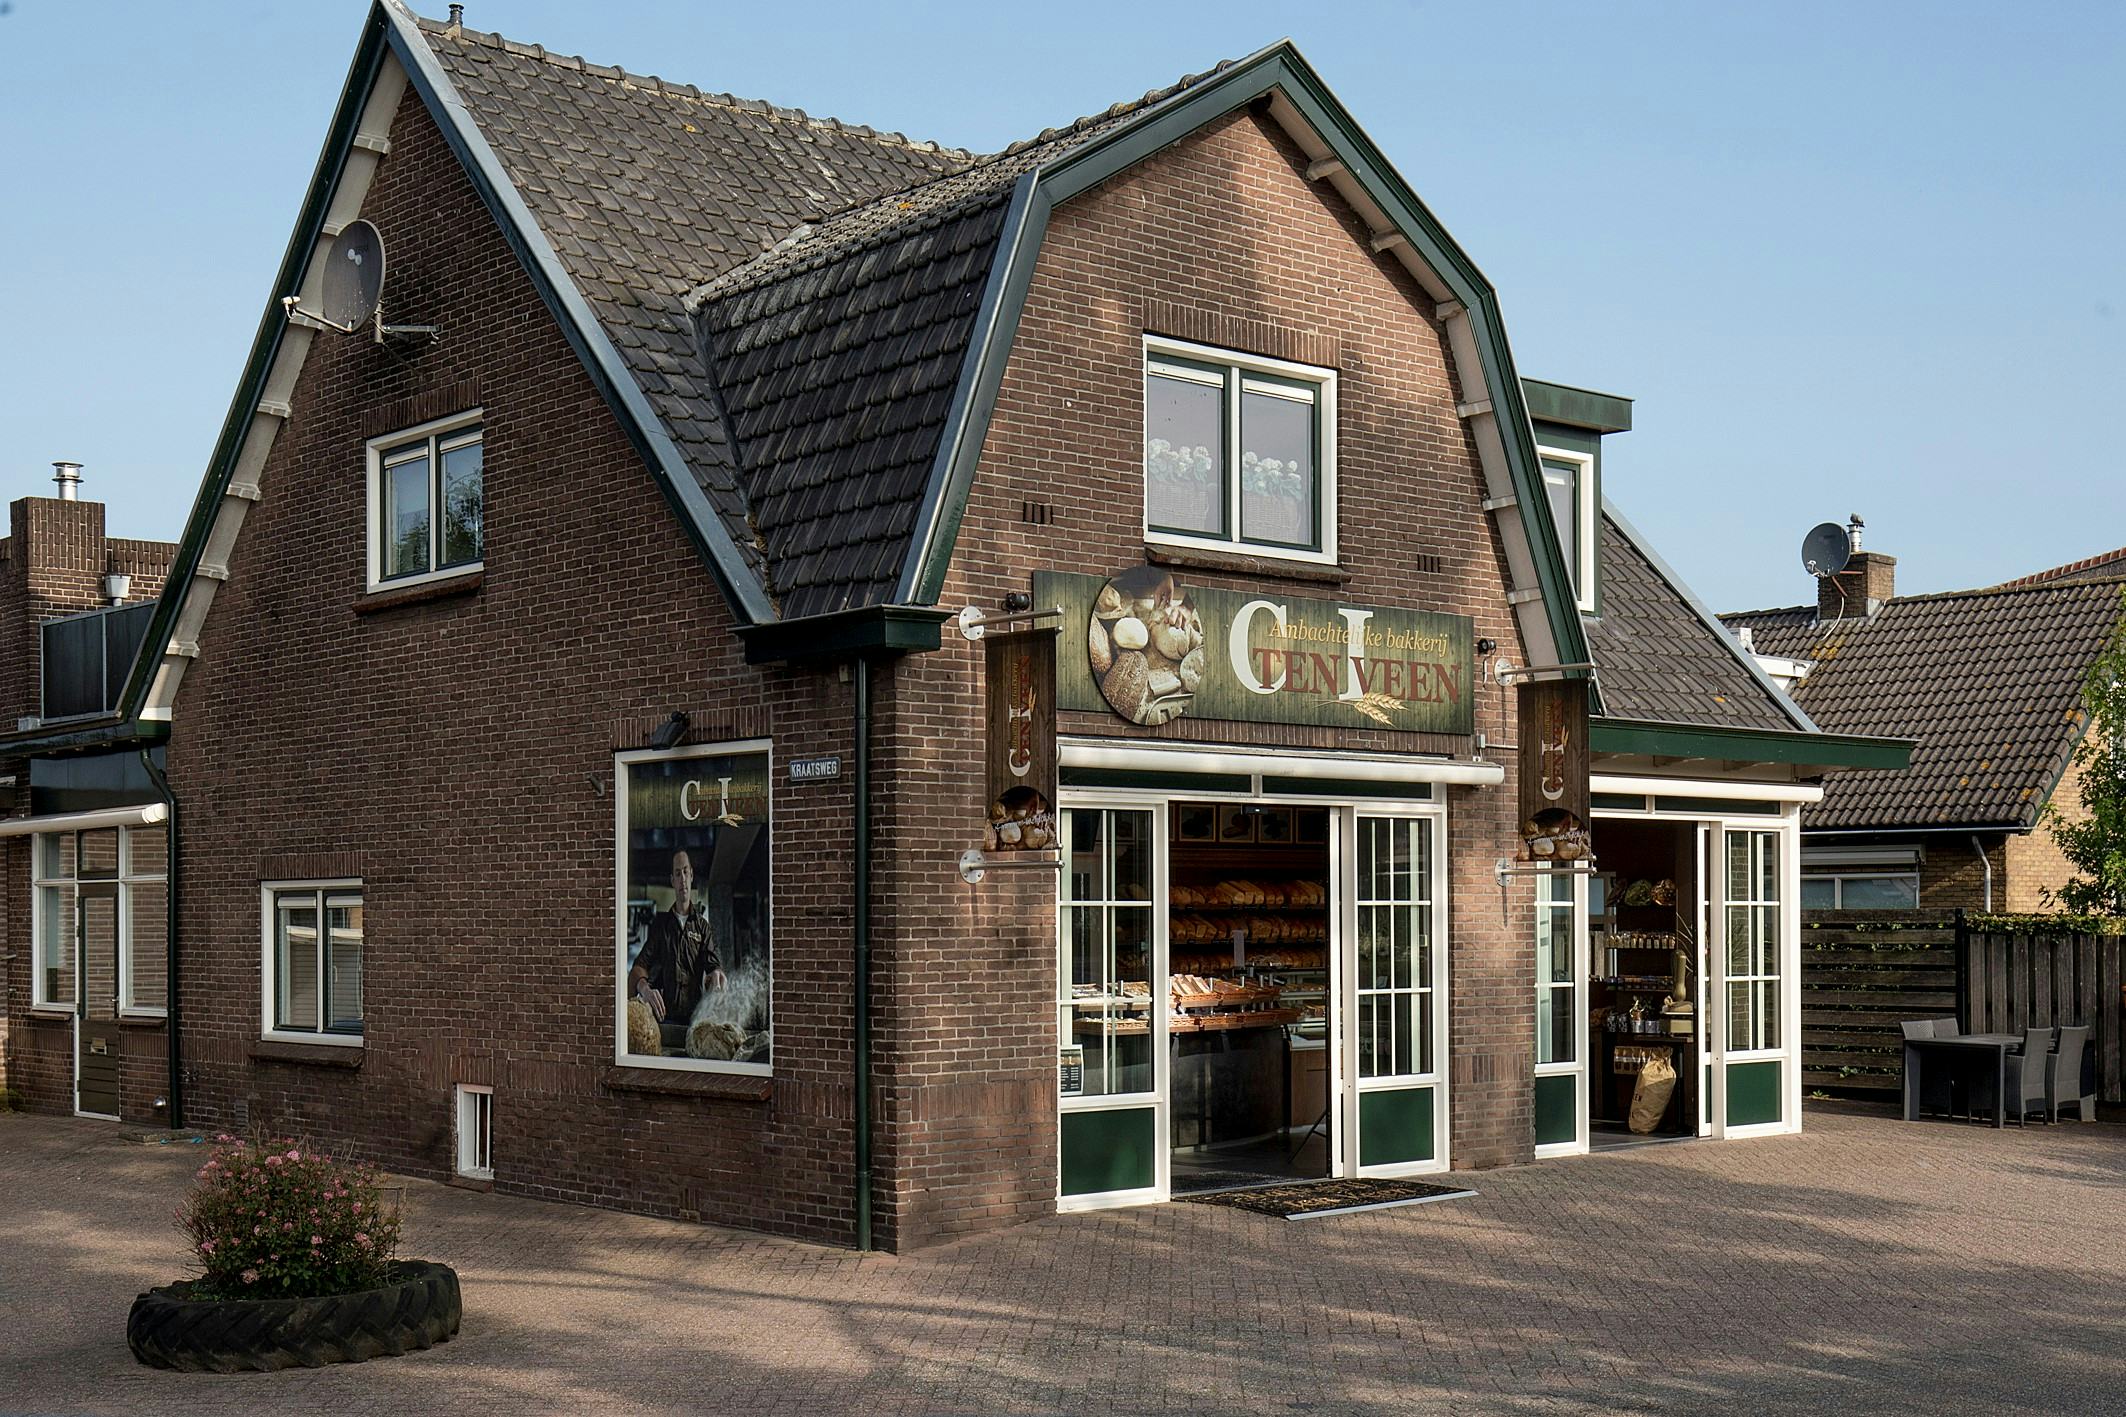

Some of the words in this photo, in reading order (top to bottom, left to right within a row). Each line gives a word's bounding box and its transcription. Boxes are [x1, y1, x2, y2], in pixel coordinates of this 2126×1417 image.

[1229, 600, 1287, 695] C
[1338, 608, 1373, 700] I
[1268, 619, 1383, 648] Ambachtelijke
[1386, 628, 1448, 657] bakkerij
[1252, 648, 1342, 696] TEN
[1349, 656, 1462, 705] VEEN
[791, 761, 837, 777] KRAATSWEG
